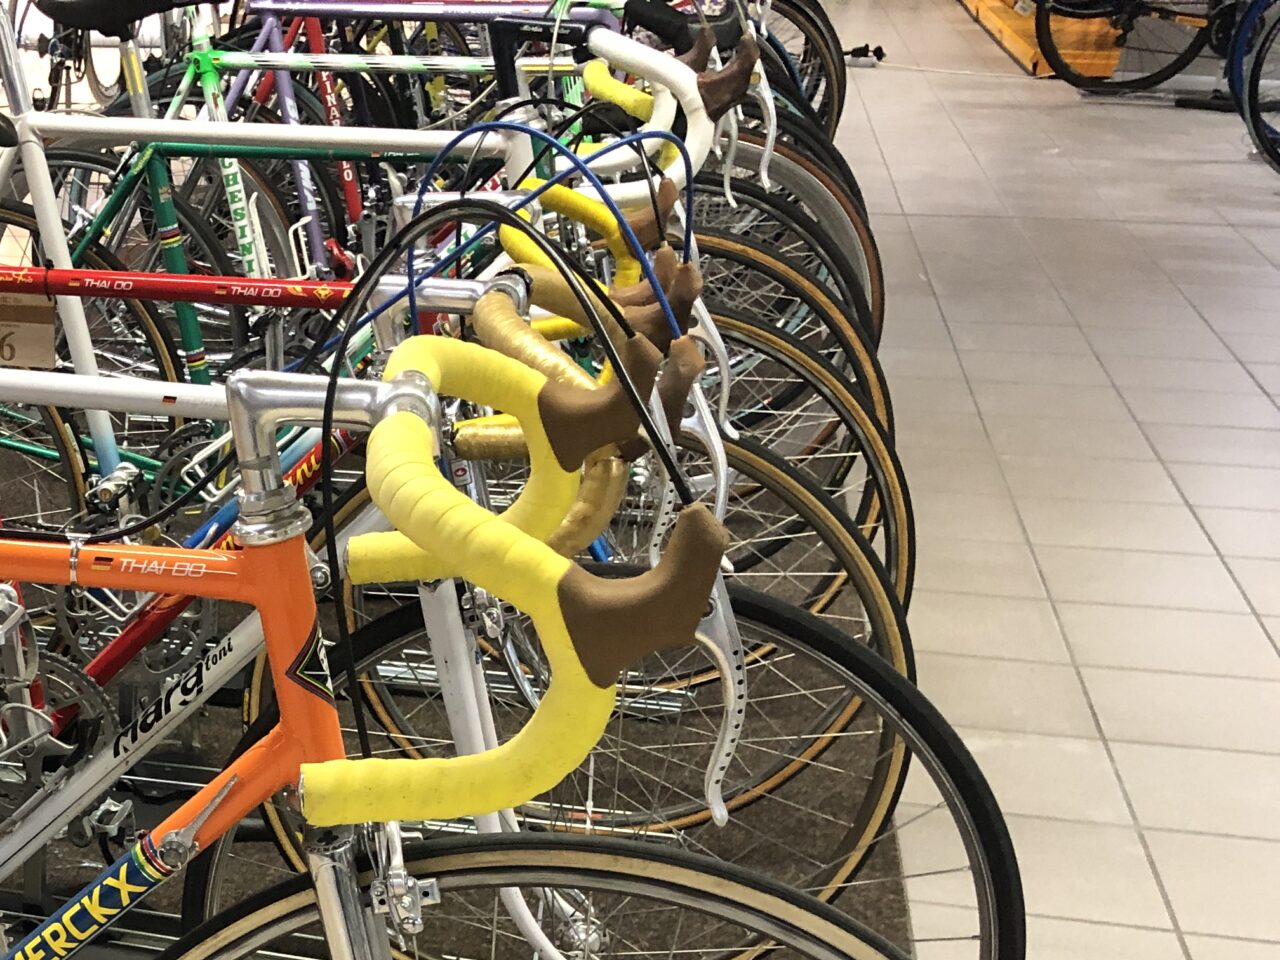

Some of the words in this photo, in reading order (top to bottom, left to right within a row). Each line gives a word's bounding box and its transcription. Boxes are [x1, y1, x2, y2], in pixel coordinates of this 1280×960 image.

[84, 278, 111, 289] THAI
[231, 286, 259, 297] THAI
[120, 558, 167, 575] THAI
